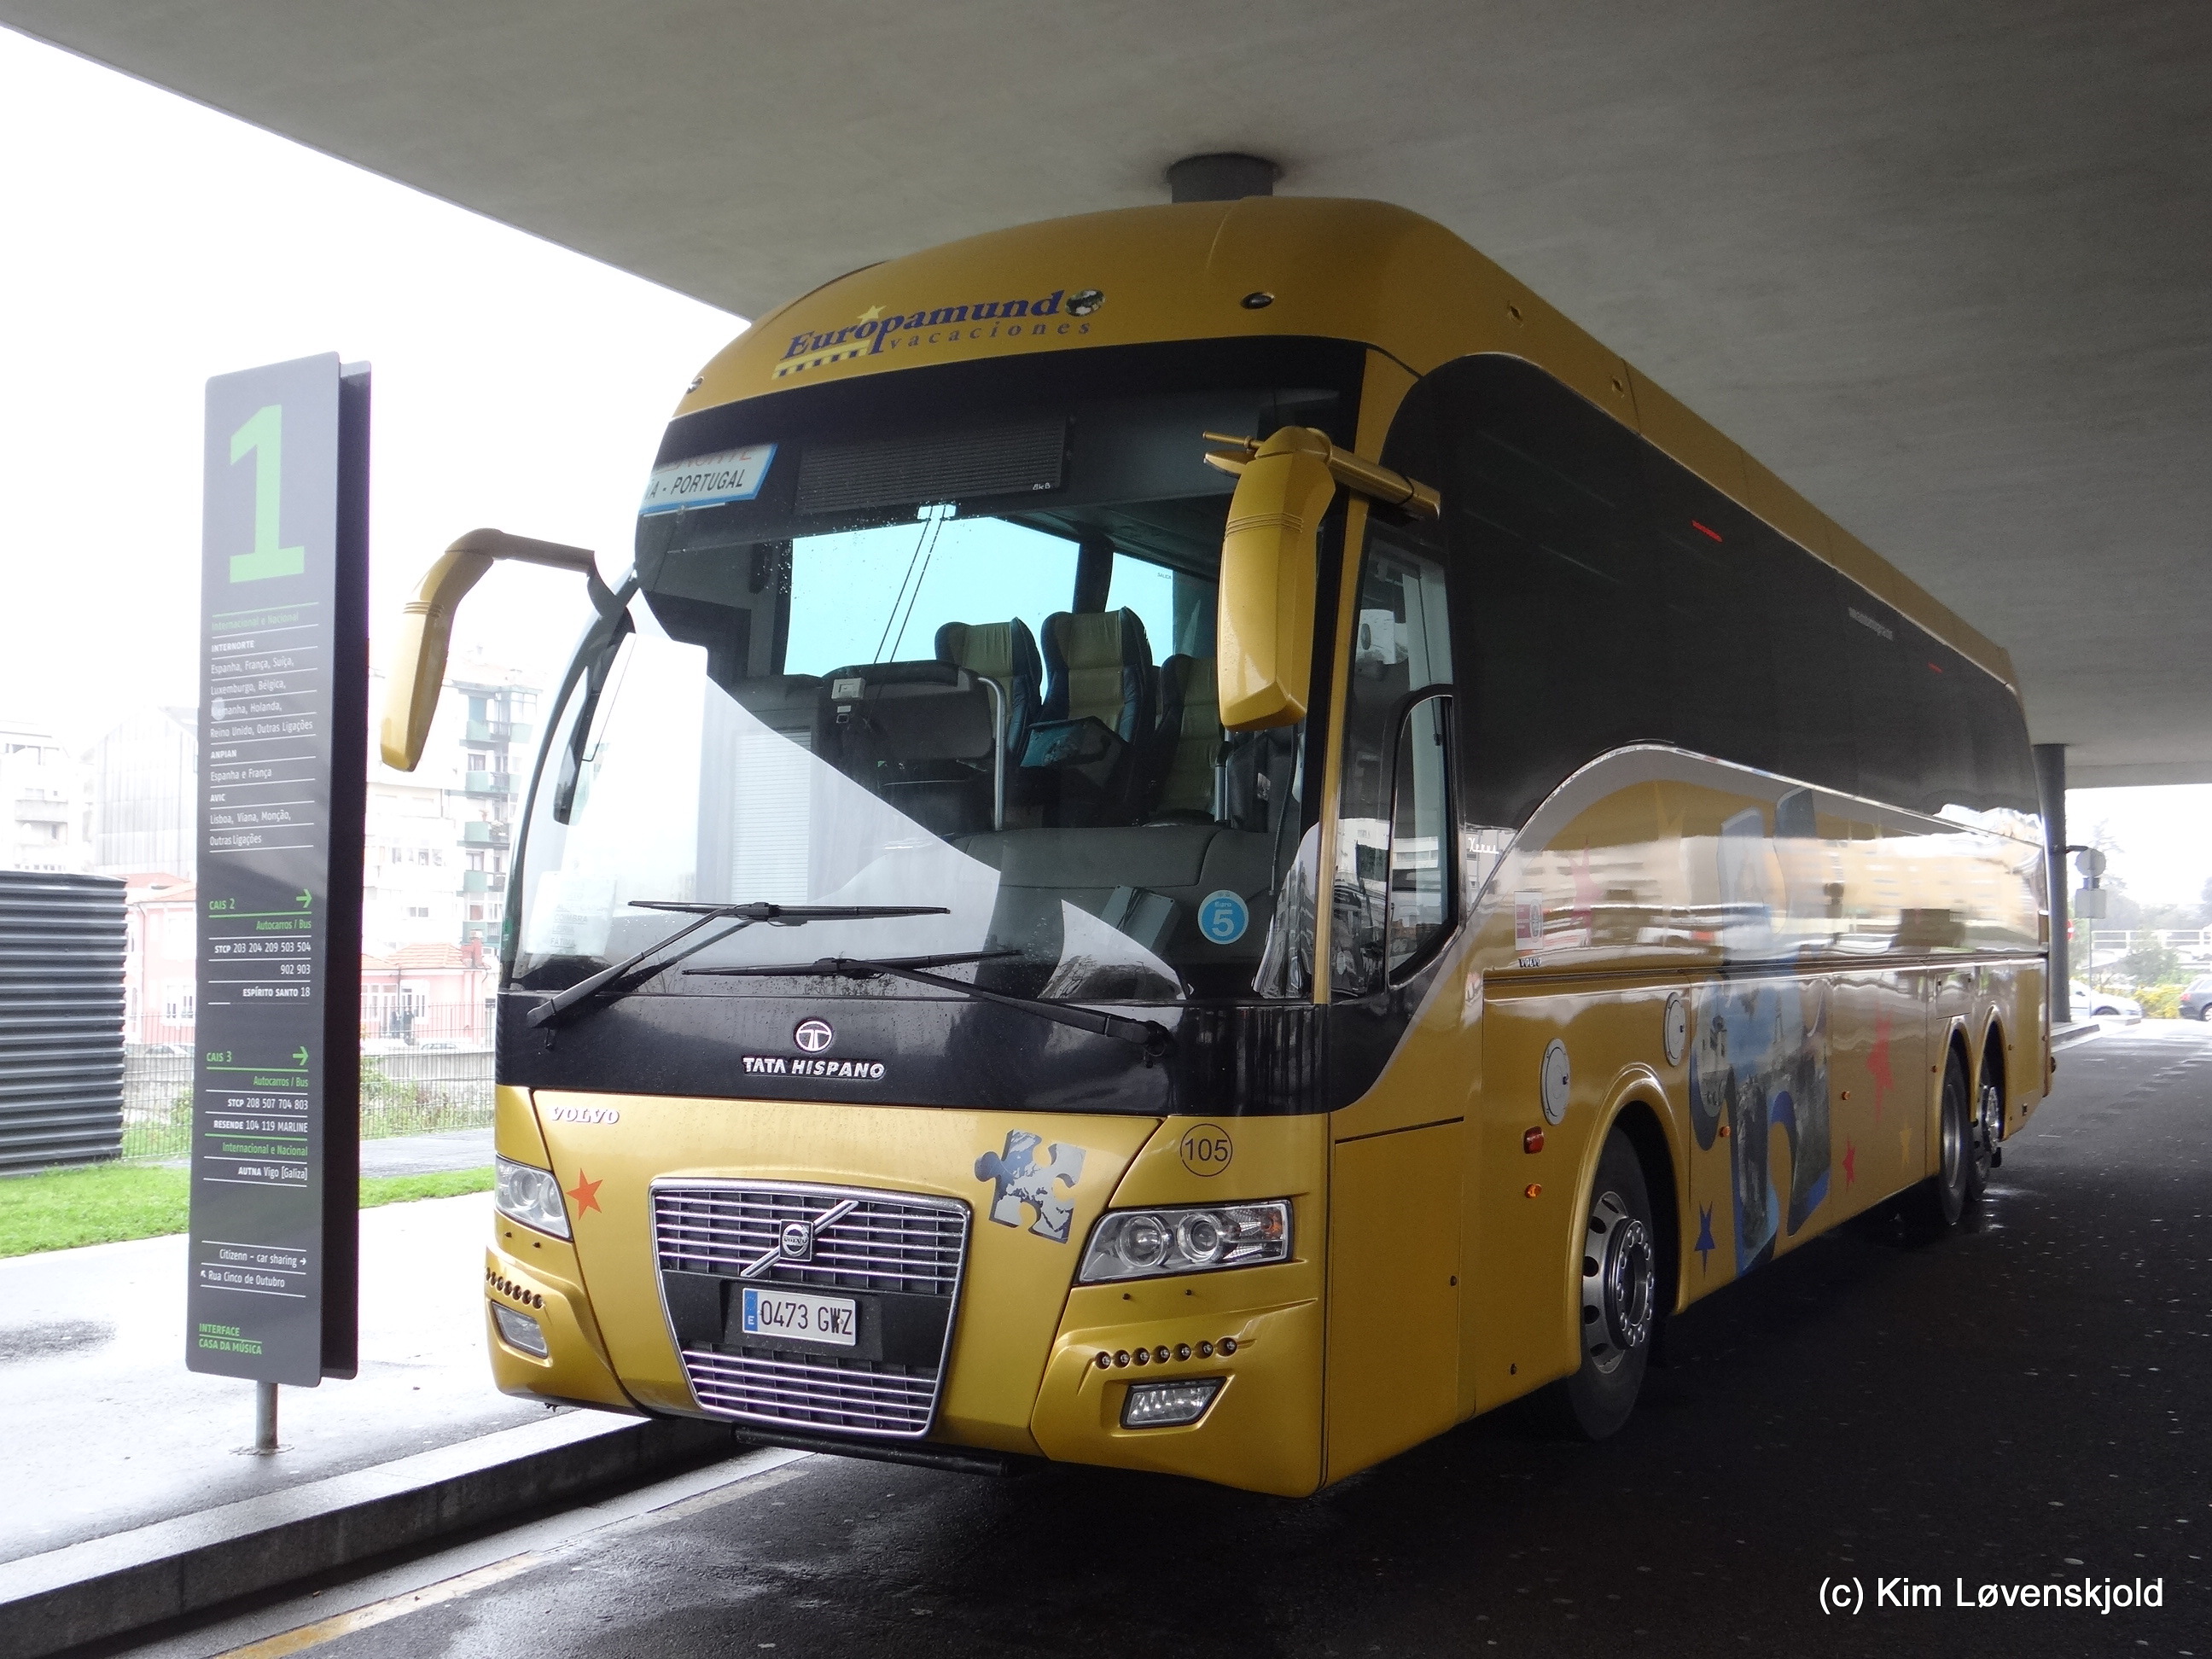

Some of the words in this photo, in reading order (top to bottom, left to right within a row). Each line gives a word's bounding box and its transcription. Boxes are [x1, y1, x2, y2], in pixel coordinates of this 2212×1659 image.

[889, 321, 1091, 349] vacaciones
[671, 469, 745, 495] PORTUGAL
[230, 404, 305, 584] 1
[212, 617, 259, 631] Internacional
[268, 613, 299, 624] Nacional
[212, 640, 254, 652] INTERNORTE
[211, 663, 242, 674] Espanha,
[245, 660, 271, 671] França,
[211, 684, 255, 696] Luxemburgo,
[259, 679, 286, 691] Bélgica,
[250, 701, 282, 713] Holanda,
[210, 728, 230, 738] Reino
[232, 725, 254, 736] Unido,
[257, 724, 280, 734] Outras
[282, 719, 313, 732] Ligações
[211, 749, 237, 759] ANPIAN
[211, 770, 239, 782] Espanha
[248, 768, 272, 779] França
[210, 793, 225, 802] AVIC
[210, 813, 234, 824] Lisboa,
[237, 812, 259, 823] Viana,
[261, 809, 291, 822] Monção,
[210, 835, 231, 846] Outras
[233, 833, 262, 847] Ligações
[209, 900, 226, 911] CAIS
[230, 898, 236, 910] 2
[256, 920, 293, 930] Autocarros
[299, 919, 311, 929] Bus
[1212, 909, 1235, 937] 5
[214, 945, 230, 953] STCP
[233, 943, 246, 953] 203
[248, 943, 262, 953] 204
[265, 942, 278, 952] 209
[281, 942, 294, 952] 503
[297, 941, 311, 952] 504
[281, 964, 294, 975] 902
[296, 964, 311, 975] 903
[242, 986, 273, 997] ESPÍRITO
[275, 988, 299, 997] SANTO
[300, 987, 311, 997] 18
[207, 1052, 224, 1062] CAIS
[226, 1051, 232, 1062] 3
[742, 1057, 786, 1074] TATA
[791, 1060, 885, 1079] HISPANO
[253, 1076, 289, 1086] Autocarros
[295, 1077, 309, 1087] Bus
[227, 1098, 244, 1108] STCP
[246, 1097, 259, 1108] 208
[262, 1098, 276, 1109] 507
[278, 1099, 292, 1109] 704
[294, 1099, 308, 1110] 803
[550, 1107, 620, 1125] VOLVO
[213, 1120, 244, 1130] RESENDE
[246, 1121, 259, 1130] 104
[262, 1121, 276, 1131] 119
[277, 1121, 308, 1132] MARLINE
[223, 1142, 269, 1154] Internacional
[276, 1144, 308, 1156] Nacional
[1185, 1138, 1229, 1162] 105
[238, 1167, 262, 1176] AUTNA
[264, 1167, 279, 1179] Vigo
[282, 1166, 308, 1180] [Galiza]
[219, 1249, 247, 1261] Citizenn
[257, 1254, 268, 1263] car
[270, 1254, 297, 1268] sharing
[208, 1270, 222, 1281] Rua
[224, 1272, 242, 1284] Cinco
[244, 1273, 253, 1284] de
[256, 1275, 285, 1288] Outubro
[748, 1316, 754, 1324] E
[760, 1301, 808, 1330] 0473
[818, 1307, 853, 1335] GWZ
[199, 1323, 240, 1336] INTERFACE
[199, 1338, 218, 1349] CASA
[220, 1341, 230, 1351] DA
[232, 1339, 262, 1354] MÚSICA
